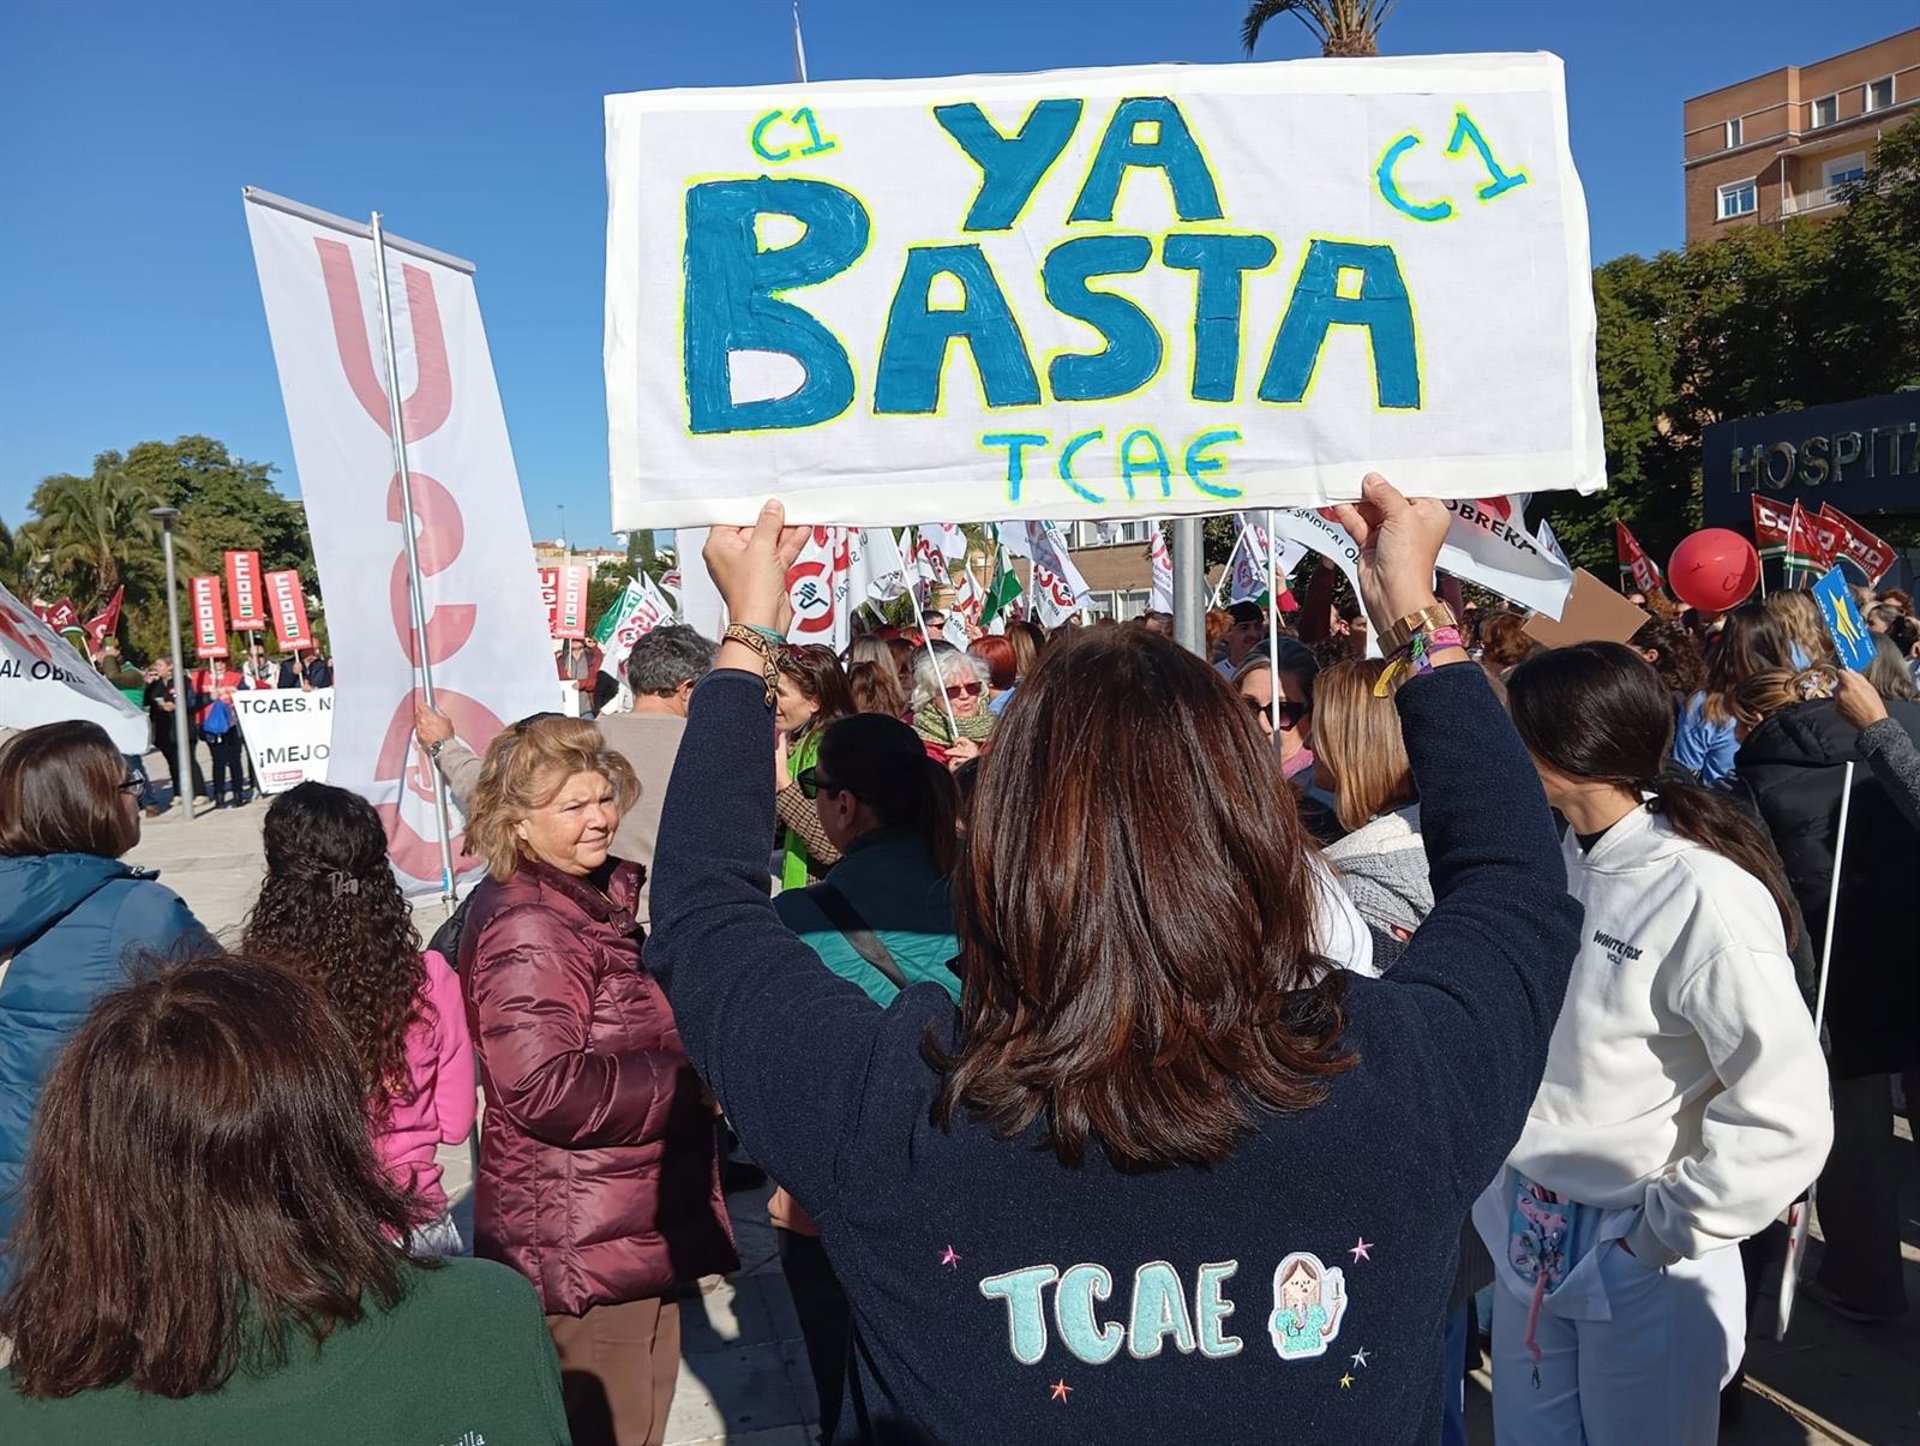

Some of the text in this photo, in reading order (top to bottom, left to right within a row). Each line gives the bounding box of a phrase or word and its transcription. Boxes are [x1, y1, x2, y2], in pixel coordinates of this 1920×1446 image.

[750, 107, 838, 161] C1
[933, 96, 1225, 231] YA
[1376, 109, 1530, 222] C1
[683, 176, 1422, 433] BASTA
[981, 428, 1244, 503] TCAE
[1593, 929, 1625, 954] WHITE
[979, 1259, 1244, 1365] TCAE
